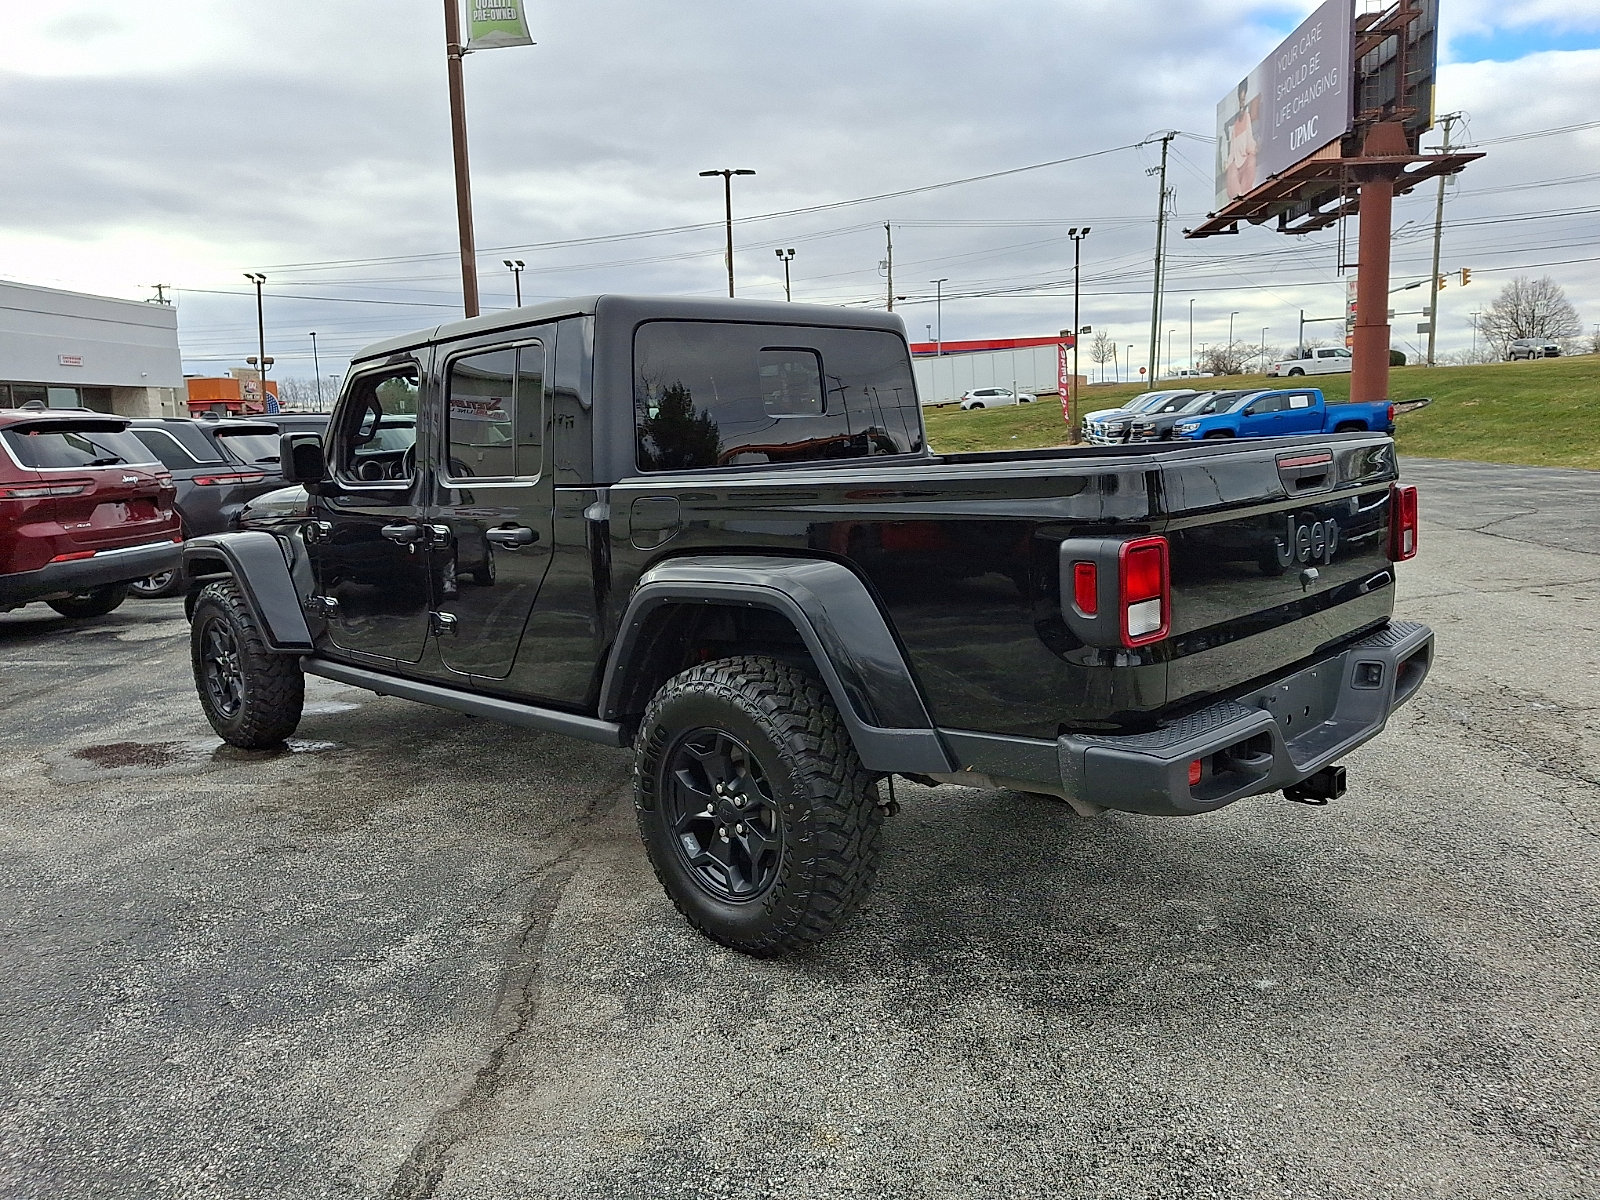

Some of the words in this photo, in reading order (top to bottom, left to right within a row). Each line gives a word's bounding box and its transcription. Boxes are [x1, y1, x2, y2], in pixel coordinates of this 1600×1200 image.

[473, 8, 517, 21] PRE-OWNED
[1277, 45, 1298, 74] YOUR
[1299, 22, 1322, 55] CARE
[1275, 103, 1292, 128] LIFE
[1292, 67, 1337, 114] CHANGING
[1276, 65, 1307, 101] SHOULD
[1309, 51, 1321, 75] BE
[1290, 115, 1319, 151] UPMC
[122, 474, 139, 484] Jeep
[1274, 514, 1339, 567] Jeep
